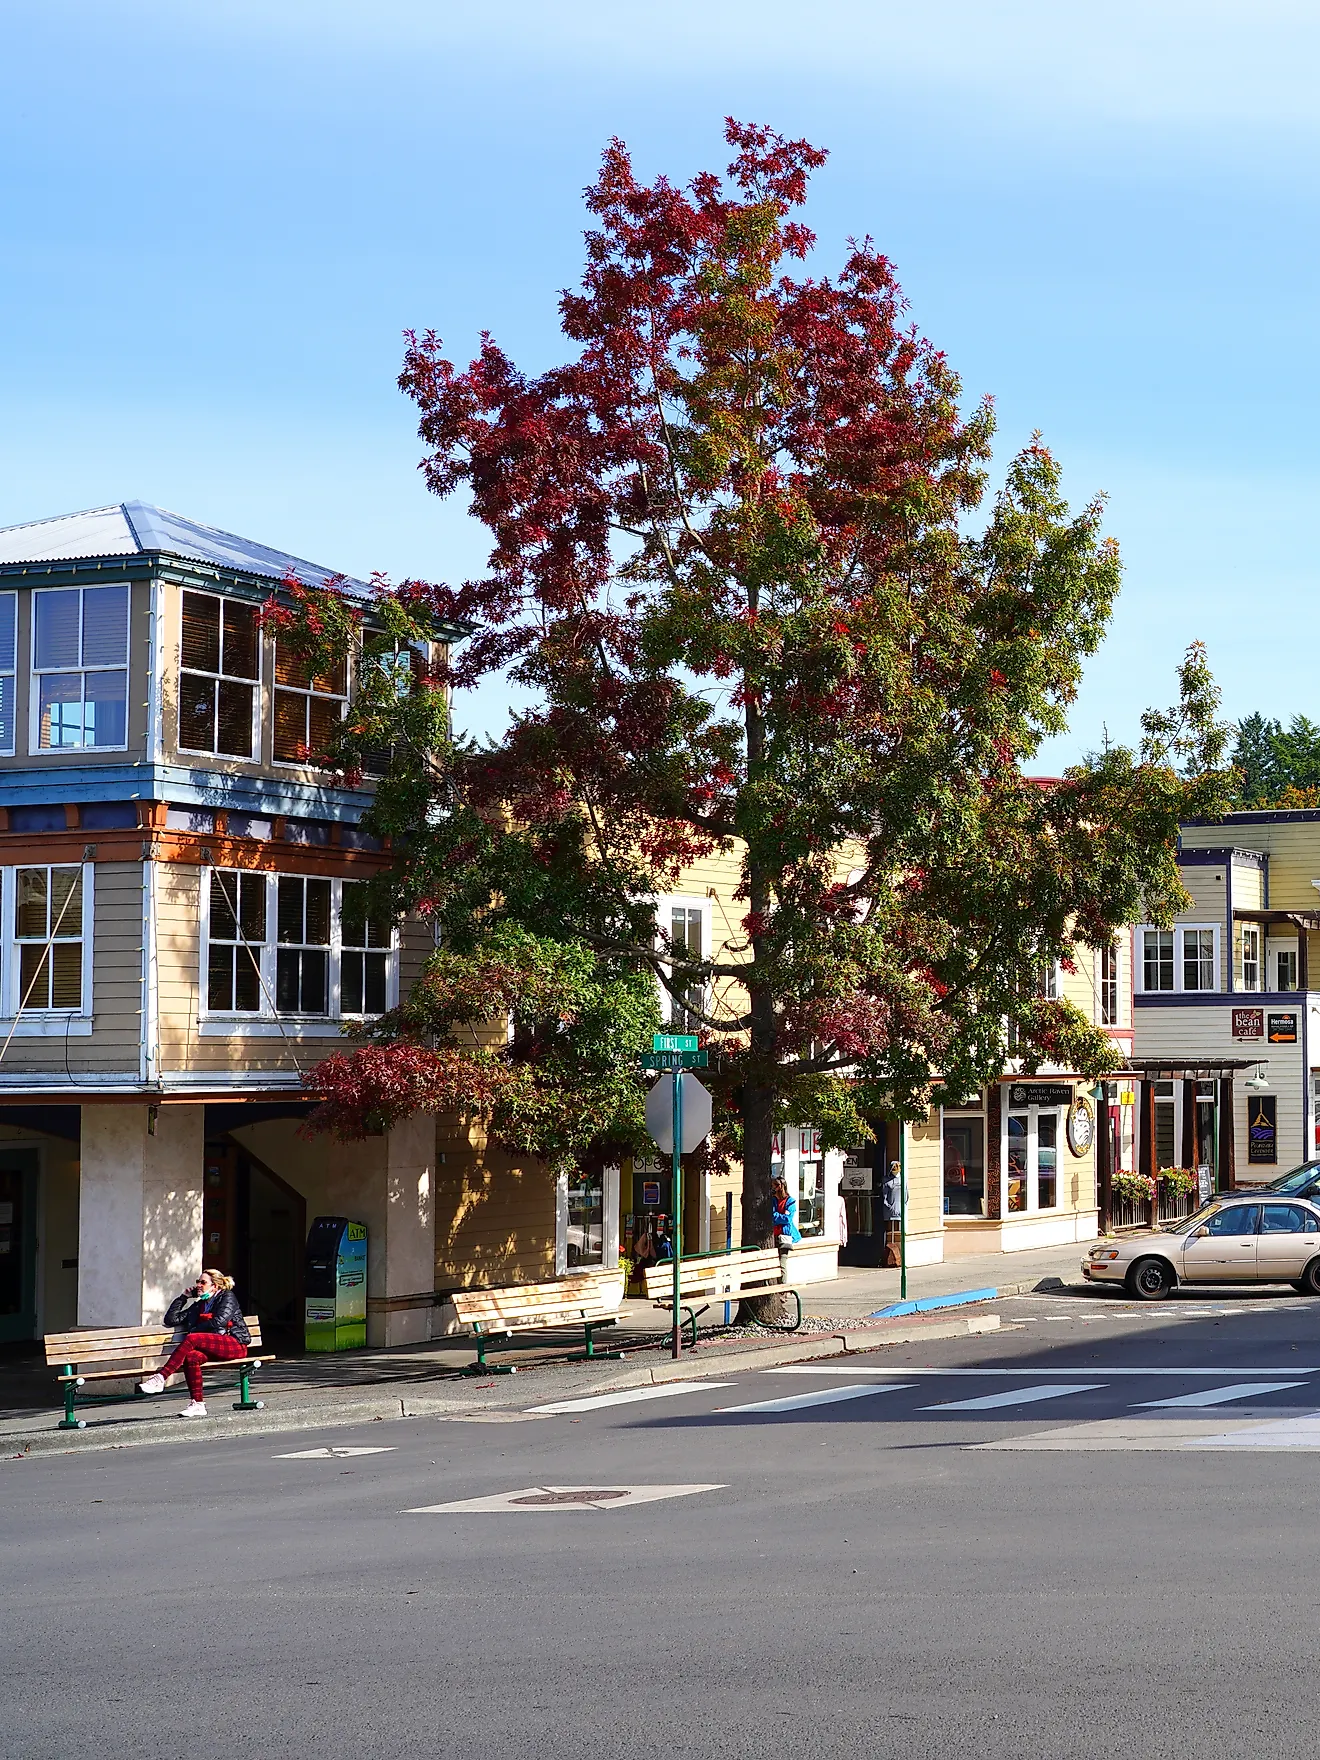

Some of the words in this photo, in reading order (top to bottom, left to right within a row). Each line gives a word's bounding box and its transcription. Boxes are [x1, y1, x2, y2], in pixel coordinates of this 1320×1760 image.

[1235, 1014, 1260, 1026] bean
[1239, 1011, 1249, 1019] the
[1238, 1027, 1257, 1035] café
[660, 1036, 678, 1049] FIRST
[685, 1039, 692, 1048] ST
[650, 1055, 683, 1067] SPRING
[692, 1055, 701, 1064] ST
[350, 1228, 366, 1239] ATM
